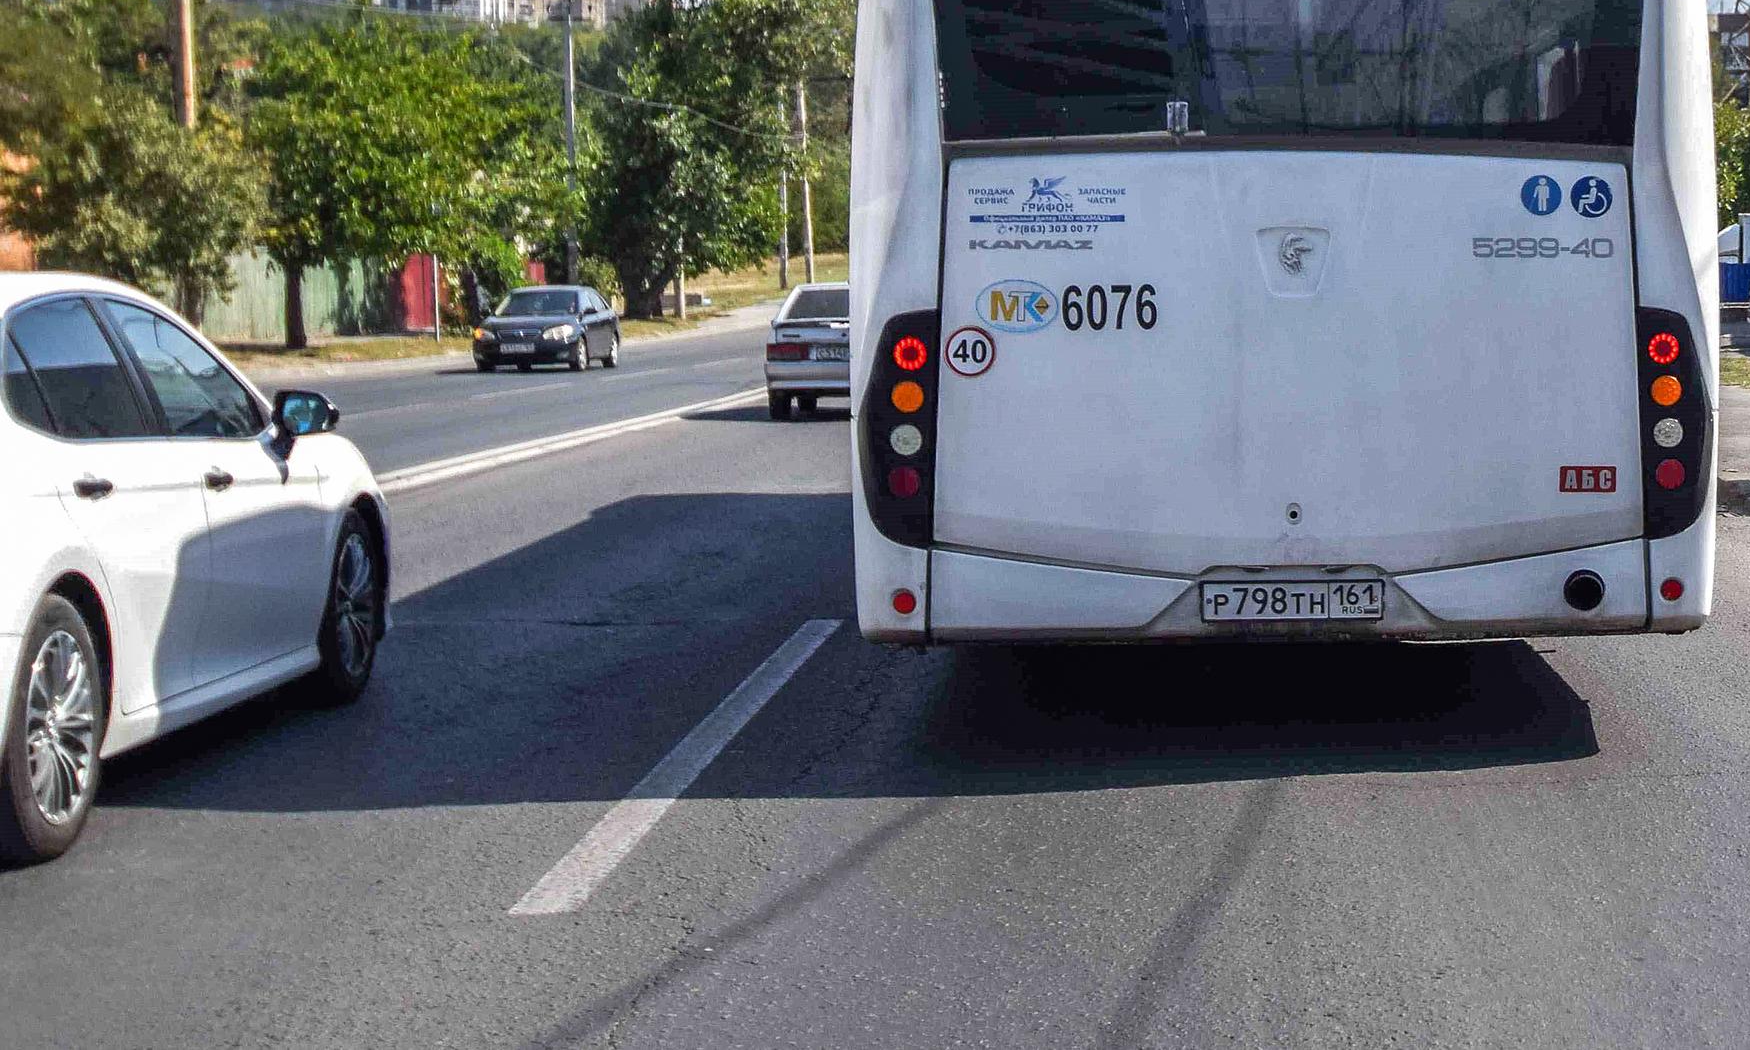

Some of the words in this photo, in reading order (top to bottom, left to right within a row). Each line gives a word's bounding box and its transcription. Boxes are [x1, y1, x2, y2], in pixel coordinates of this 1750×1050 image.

[968, 188, 1015, 196] ПРОДАЖА
[1078, 188, 1127, 196] ЗАПАСНЫЕ
[974, 196, 1009, 205] СЕРВИС
[1087, 196, 1117, 205] ЧАСТИ
[1021, 202, 1075, 213] ГРИФОН
[1008, 224, 1046, 235] +7(863)
[1049, 224, 1068, 234] 303
[1070, 224, 1083, 233] 00
[1085, 224, 1099, 233] 77
[968, 239, 1094, 251] KAMAZ
[1472, 236, 1615, 259] 5299-40
[1061, 284, 1159, 332] 6076
[952, 339, 988, 364] 40
[1564, 469, 1613, 490] АБС
[1332, 583, 1375, 607] 161
[1341, 605, 1364, 615] RUS
